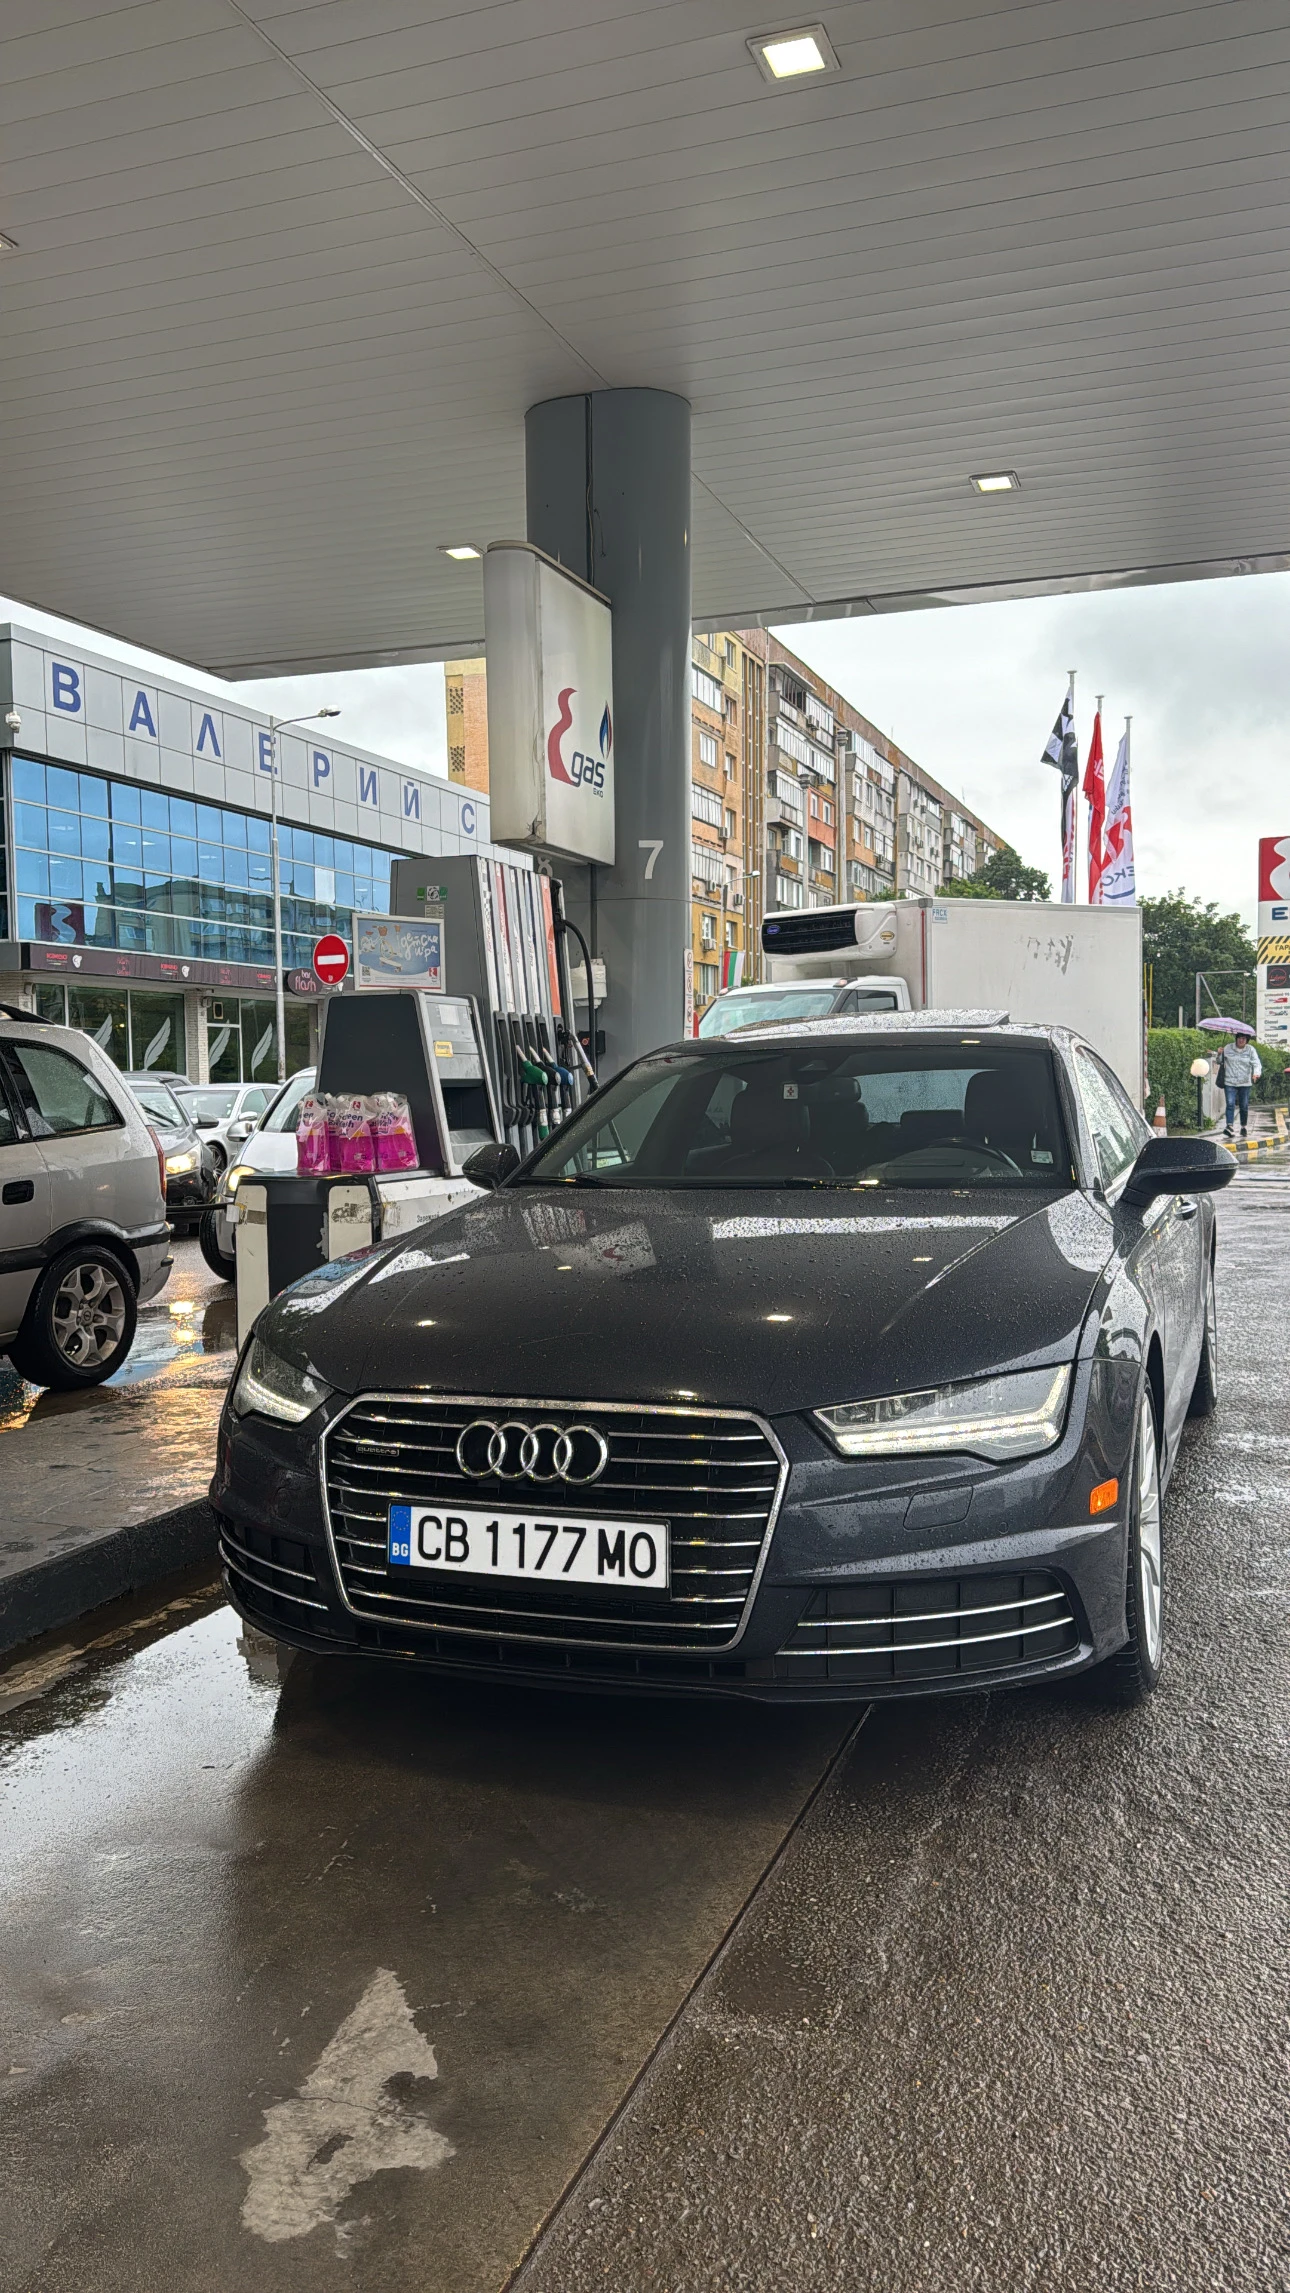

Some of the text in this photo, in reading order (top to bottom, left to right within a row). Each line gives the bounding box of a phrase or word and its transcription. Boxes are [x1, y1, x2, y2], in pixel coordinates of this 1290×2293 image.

[52, 662, 421, 820] ВАЛЕРИЙ
[571, 751, 606, 788] gas
[593, 788, 604, 798] EKO
[638, 840, 664, 880] 7
[1271, 906, 1289, 921] E
[295, 975, 317, 992] flash
[357, 1446, 397, 1454] quattro
[392, 1542, 409, 1557] BG
[418, 1515, 657, 1579] CB 1177 MO
